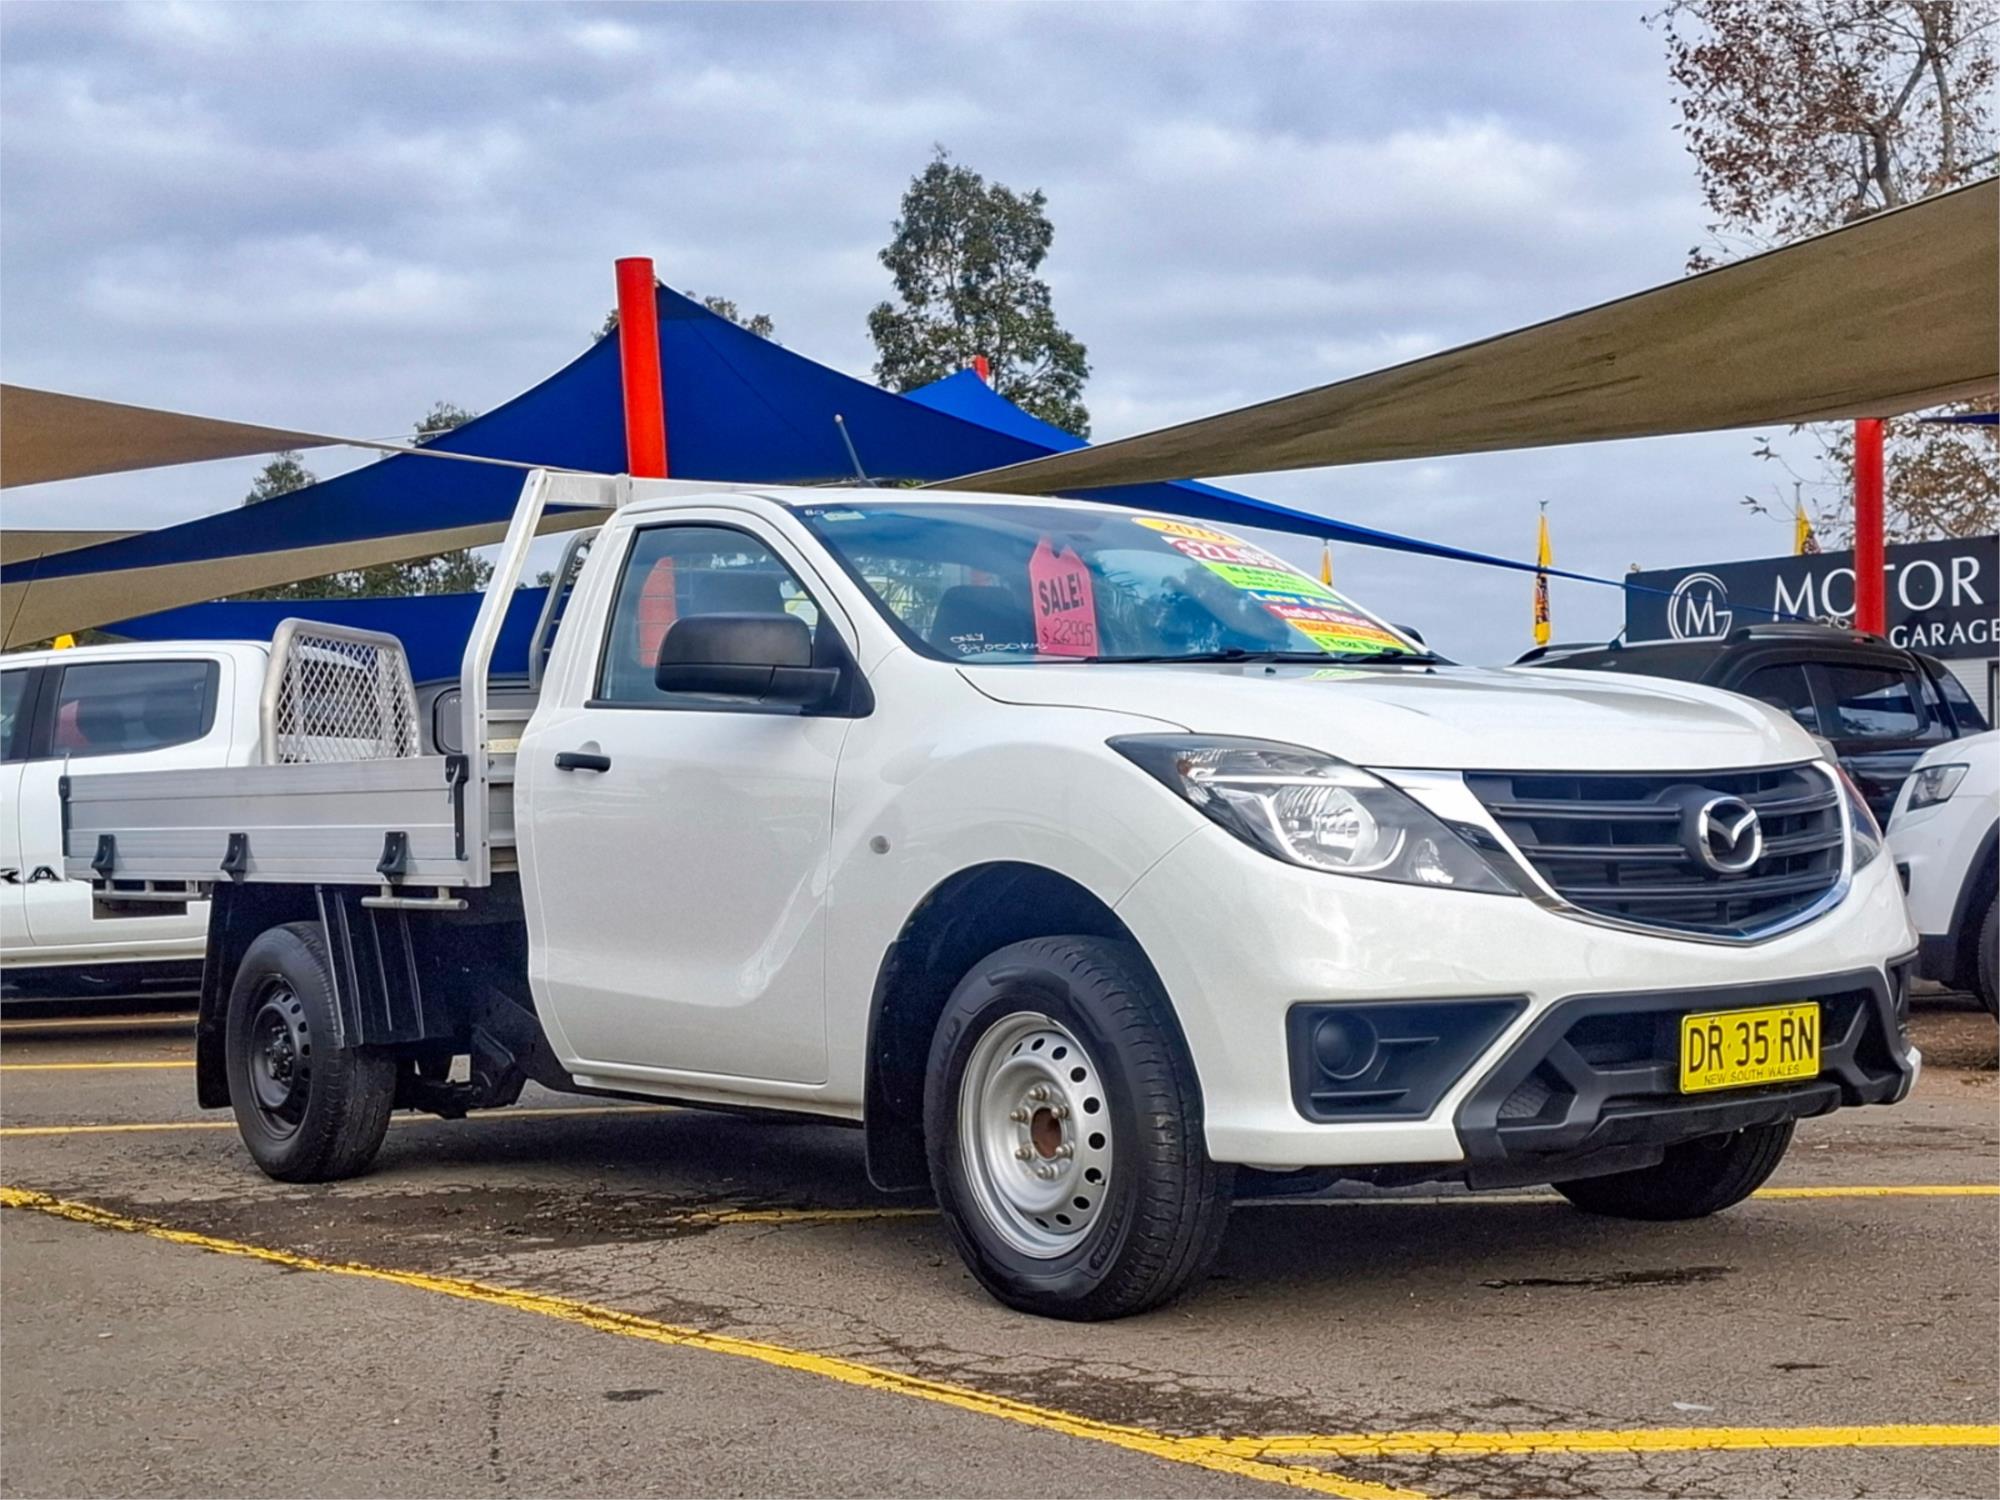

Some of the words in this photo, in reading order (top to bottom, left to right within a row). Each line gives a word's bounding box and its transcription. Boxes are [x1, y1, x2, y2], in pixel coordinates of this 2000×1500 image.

[1038, 572, 1085, 617] SALE!
[1688, 1024, 1725, 1073] DR
[1735, 1019, 1770, 1067] 35
[1780, 1015, 1815, 1063] RN
[1703, 1074, 1727, 1086] NEW
[1730, 1070, 1764, 1082] SOUTH
[1768, 1064, 1801, 1077] WALES
